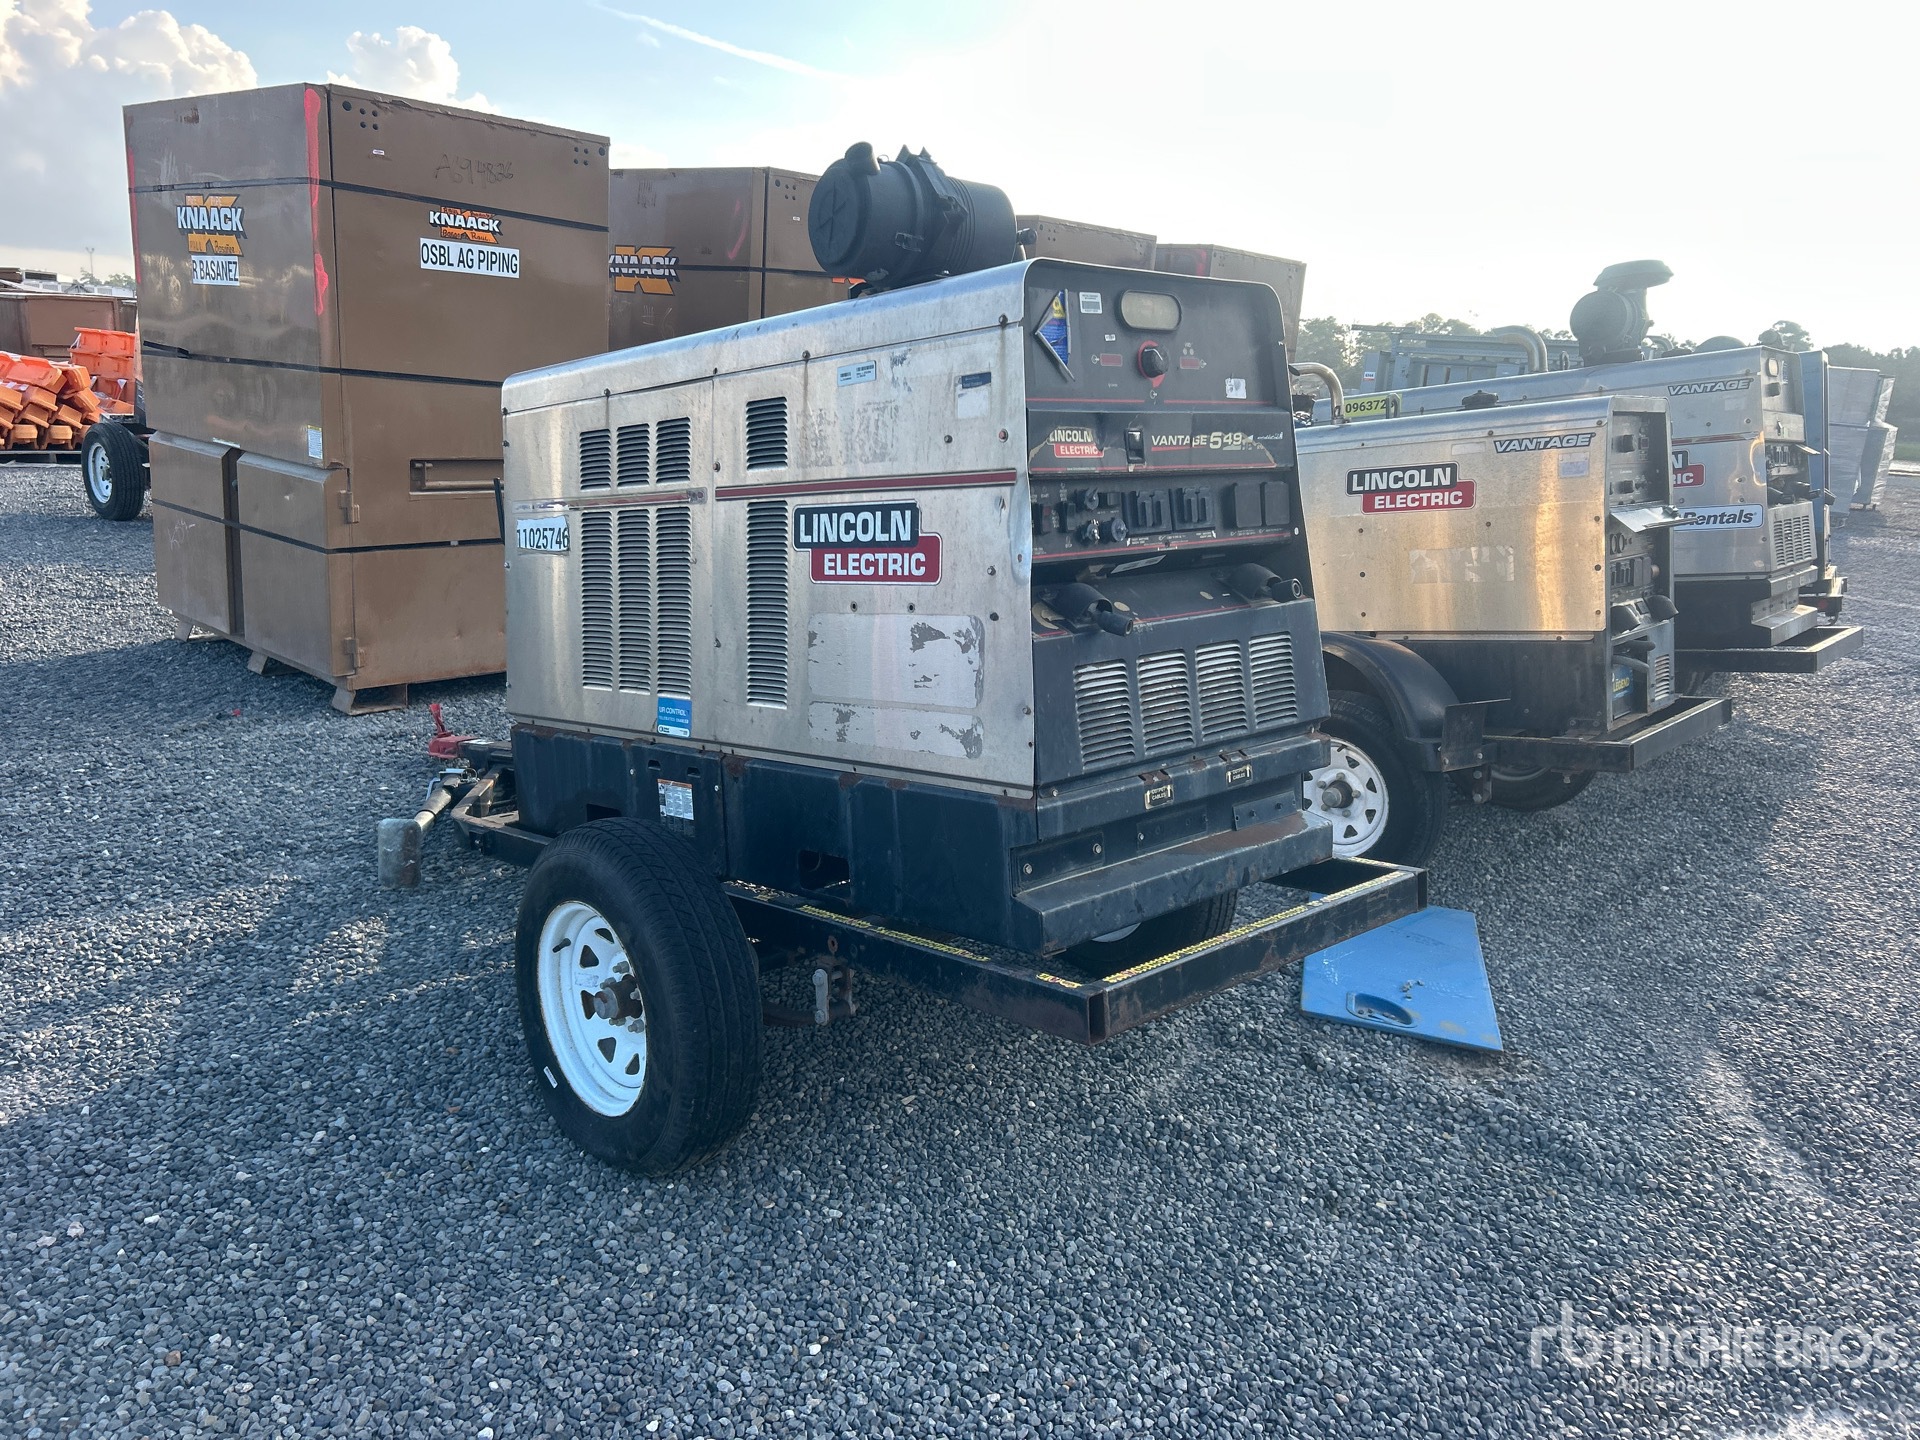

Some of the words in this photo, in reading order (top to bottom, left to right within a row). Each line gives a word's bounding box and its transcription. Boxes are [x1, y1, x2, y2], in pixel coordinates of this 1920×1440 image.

[176, 206, 243, 231] KNAACK
[429, 210, 500, 232] KNAACK
[421, 243, 454, 267] OSBL
[457, 247, 474, 269] AG
[478, 249, 518, 274] PIPING
[192, 260, 198, 279] R
[200, 260, 239, 281] BASANEZ
[1668, 379, 1750, 396] VANTAGE
[1060, 445, 1099, 455] ELECTRIC
[1151, 434, 1208, 447] VANTAGE
[1494, 433, 1592, 453] VANTAGE
[1352, 467, 1451, 491] LINCOLN
[1374, 490, 1463, 509] ELECTRIC
[799, 510, 912, 543] LINCOLN
[517, 527, 570, 549] 11025746
[824, 552, 926, 576] ELECTRIC
